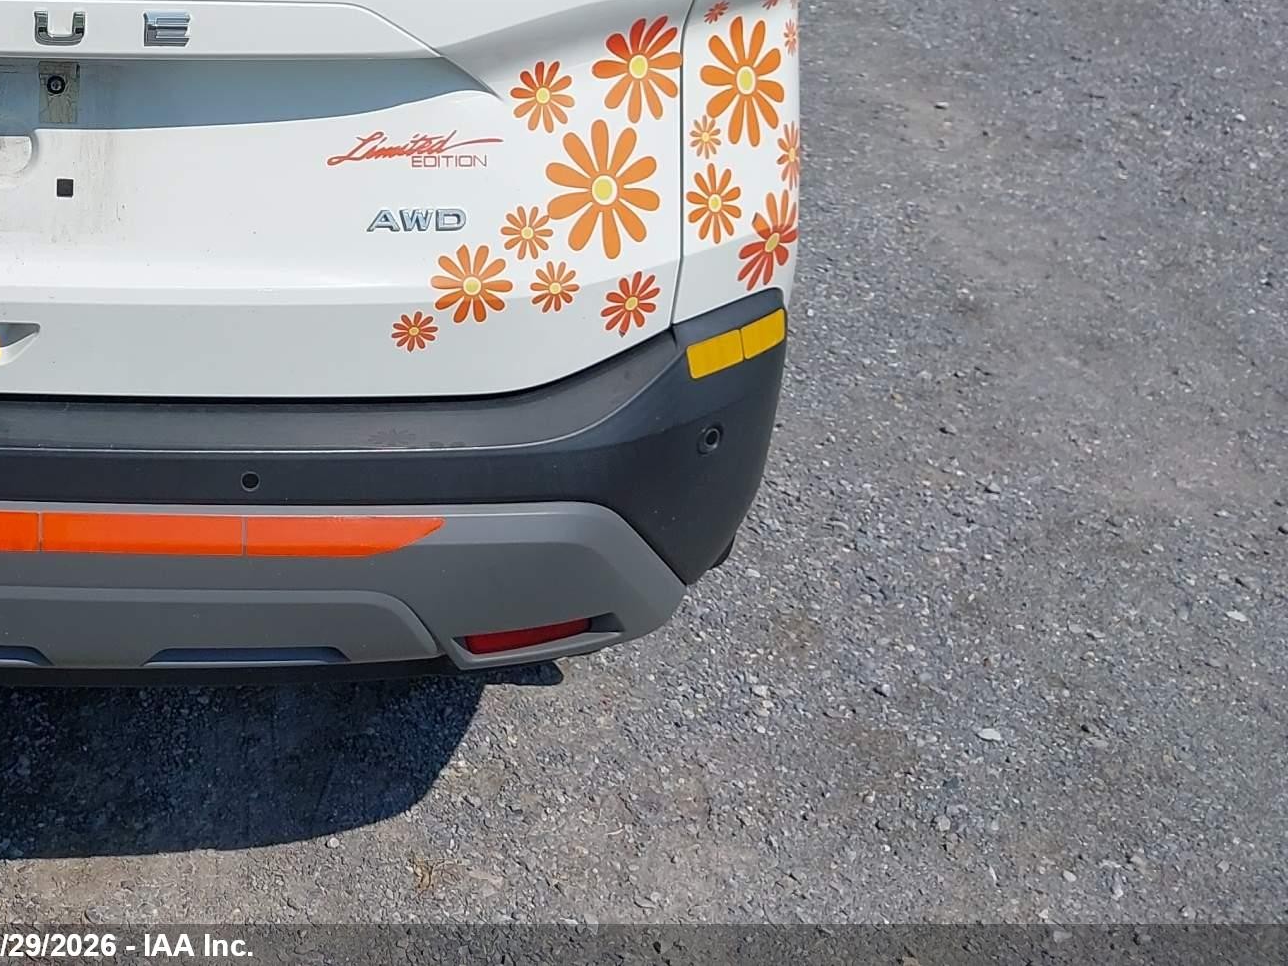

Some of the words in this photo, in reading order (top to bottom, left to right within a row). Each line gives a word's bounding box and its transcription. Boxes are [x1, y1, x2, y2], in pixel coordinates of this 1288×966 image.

[327, 130, 504, 166] Limited
[411, 155, 488, 168] EDITION
[367, 209, 467, 232] AWD
